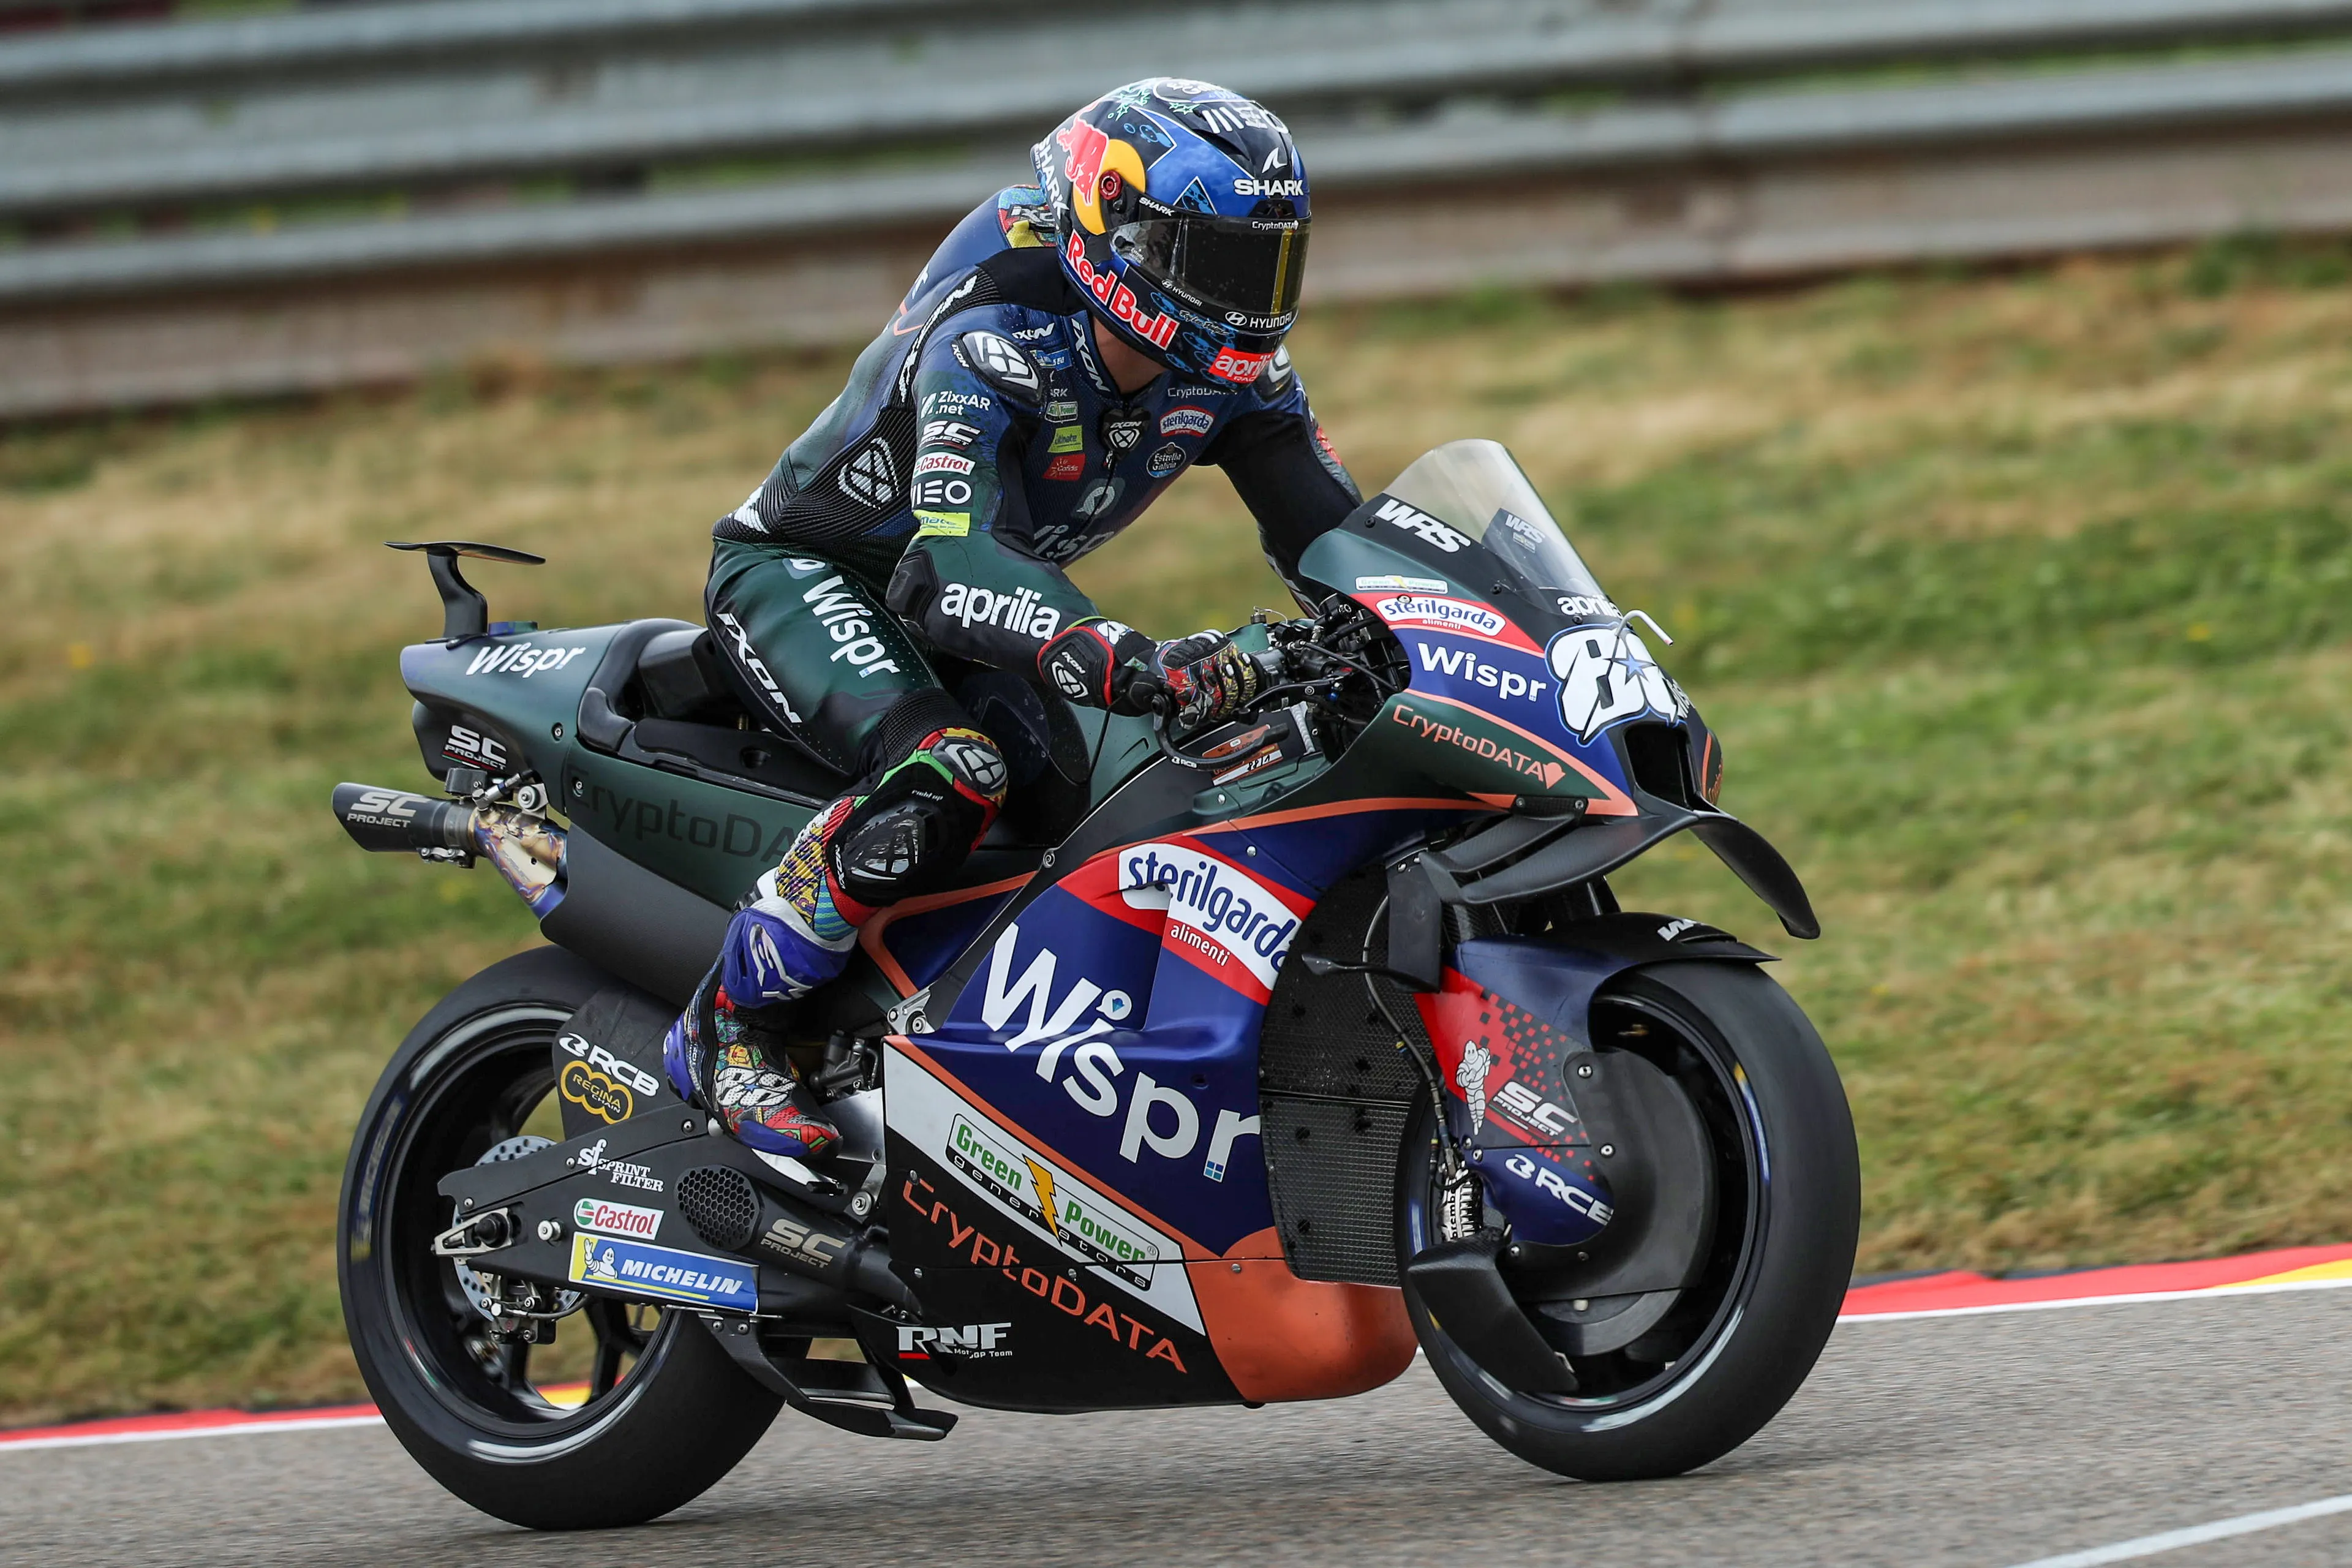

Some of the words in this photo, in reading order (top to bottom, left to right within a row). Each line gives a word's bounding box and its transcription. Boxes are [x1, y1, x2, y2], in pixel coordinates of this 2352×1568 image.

[1234, 179, 1303, 195] SHARK
[1139, 197, 1174, 216] SHARK
[1067, 230, 1118, 306] Red
[1109, 282, 1180, 350] Bull
[1172, 286, 1202, 306] HYUNDAI
[1250, 312, 1292, 329] HYUNDAI
[951, 344, 969, 368] IXON
[1071, 318, 1111, 392] IXON
[935, 404, 964, 417] .net
[938, 391, 990, 411] ZixxAR
[921, 420, 981, 443] SC
[920, 455, 969, 472] Castrol
[1153, 452, 1182, 463] Estrella
[1375, 498, 1471, 553] WRS
[1505, 514, 1545, 544] WRS
[803, 575, 900, 678] Wispr
[940, 581, 1062, 641] aprilia
[1384, 600, 1497, 630] sterilgarda
[1422, 619, 1462, 630] alimenti
[466, 642, 587, 678] Wispr
[716, 612, 803, 724] IXON
[1061, 651, 1086, 674] IXON
[1417, 641, 1547, 703] Wispr
[444, 744, 508, 772] PROJECT
[450, 725, 508, 764] SC
[1392, 704, 1545, 783] CryptoDATA
[347, 812, 411, 829] PROJECT
[350, 791, 429, 818] SC
[568, 764, 798, 863] CryptoDA
[1170, 924, 1231, 967] alimenti
[981, 921, 1261, 1183] Wispr
[588, 1047, 660, 1097] RCB
[572, 1072, 622, 1109] REGINA
[592, 1093, 622, 1114] CHAIN
[1491, 1095, 1559, 1137] PROJECT
[1504, 1080, 1578, 1134] SC
[598, 1157, 651, 1178] SPRINT
[610, 1171, 664, 1193] FILTER
[955, 1123, 1023, 1193] Green
[1063, 1199, 1146, 1262] Power
[594, 1204, 656, 1236] Castrol
[760, 1238, 829, 1270] PROJECT
[764, 1218, 846, 1262] SC
[620, 1258, 743, 1295] MICHELIN
[902, 1178, 1188, 1374] CryptoDATA
[896, 1322, 1012, 1355] RNF
[989, 1349, 1012, 1358] Team
